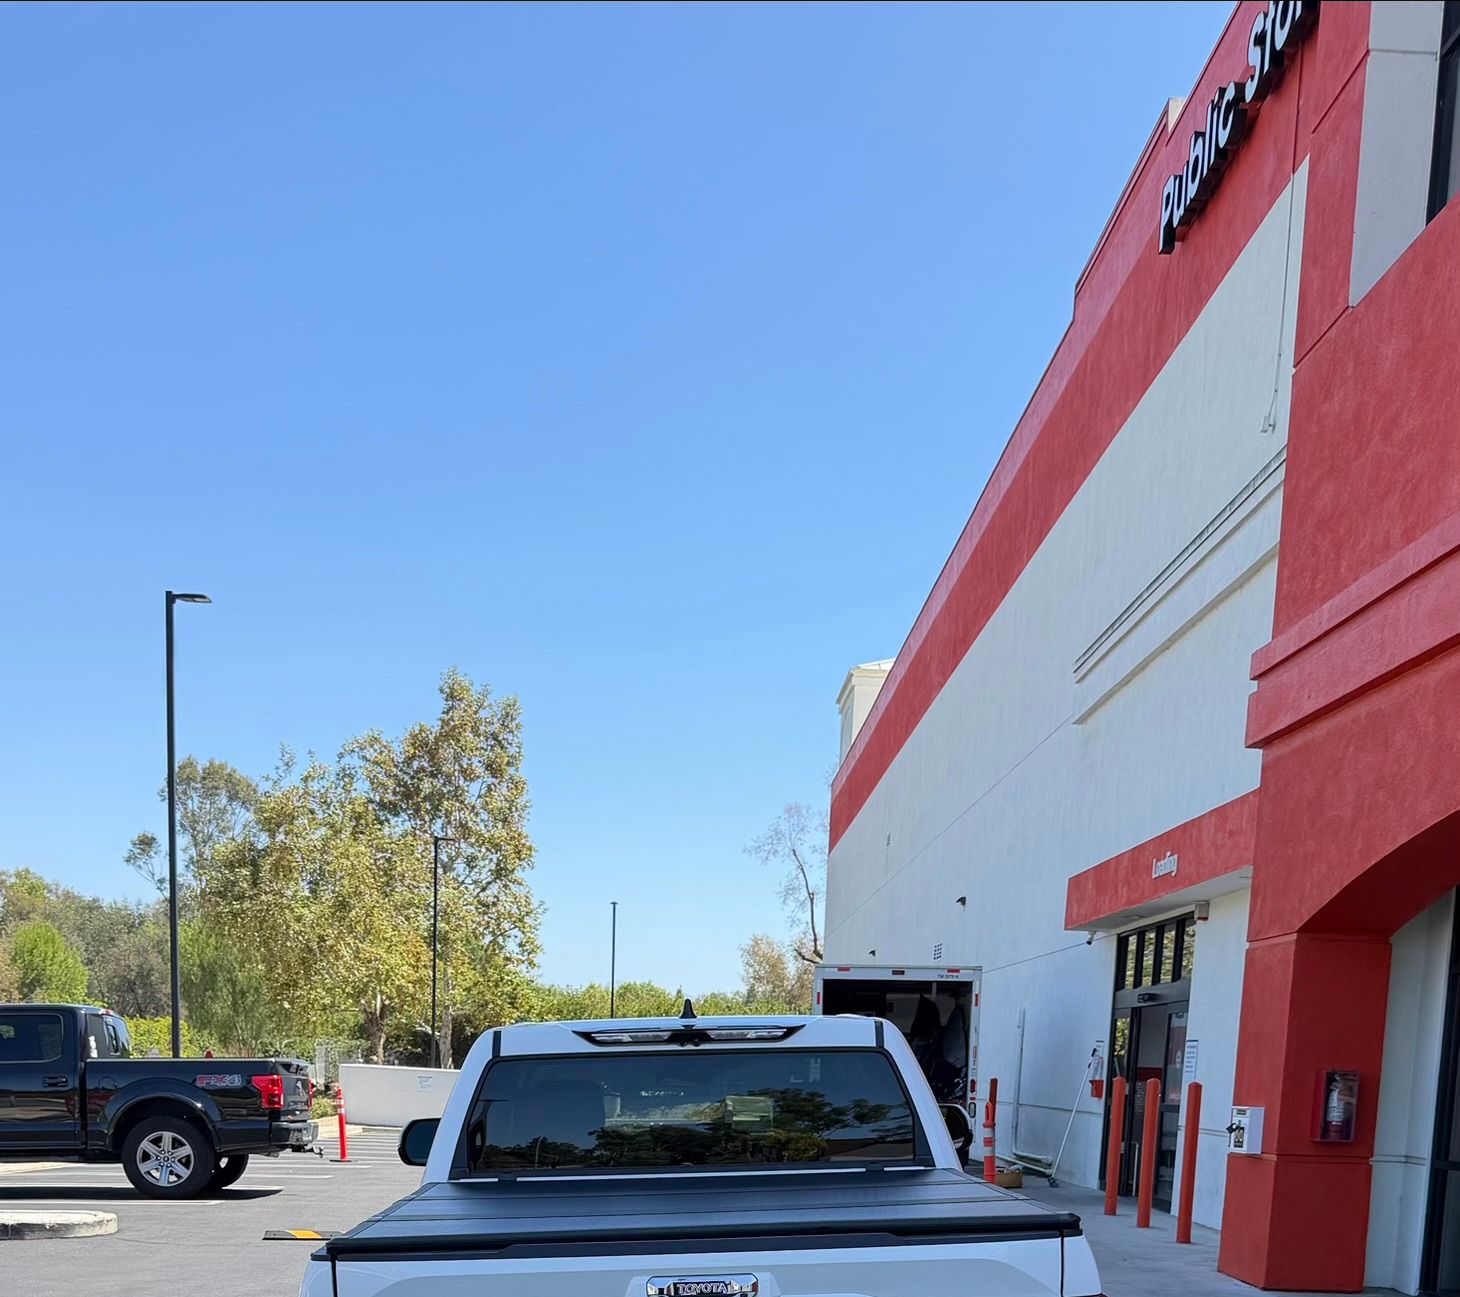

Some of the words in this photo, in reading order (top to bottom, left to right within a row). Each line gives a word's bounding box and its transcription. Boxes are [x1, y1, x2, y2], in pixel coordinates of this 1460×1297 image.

[1158, 81, 1236, 255] Public
[1151, 851, 1178, 879] Loading
[196, 1075, 242, 1088] FX4
[676, 1282, 729, 1296] TOYOTA
